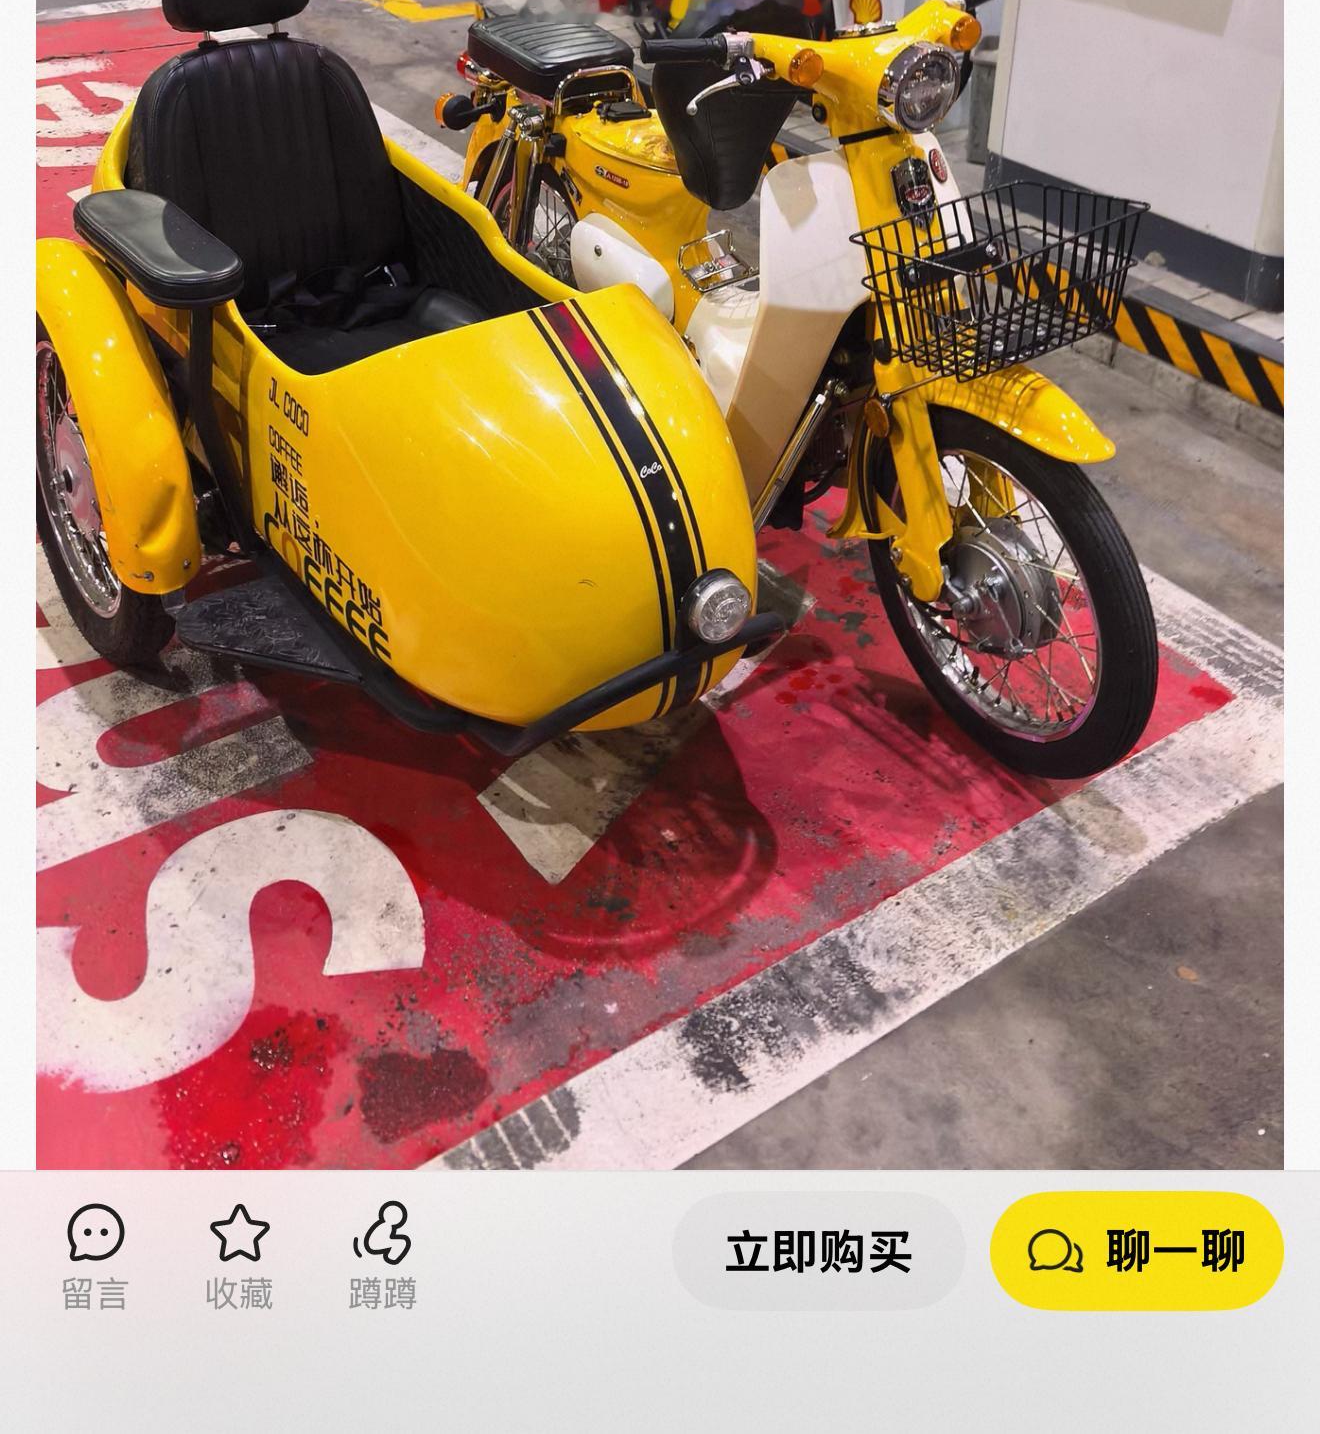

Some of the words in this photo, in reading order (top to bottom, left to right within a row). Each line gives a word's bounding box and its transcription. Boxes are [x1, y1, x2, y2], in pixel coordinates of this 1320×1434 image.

[269, 377, 280, 409] JL
[284, 391, 310, 437] COCO
[269, 424, 303, 477] COFFEE
[640, 461, 662, 478] CoCo
[274, 491, 382, 627] 从这杯开始
